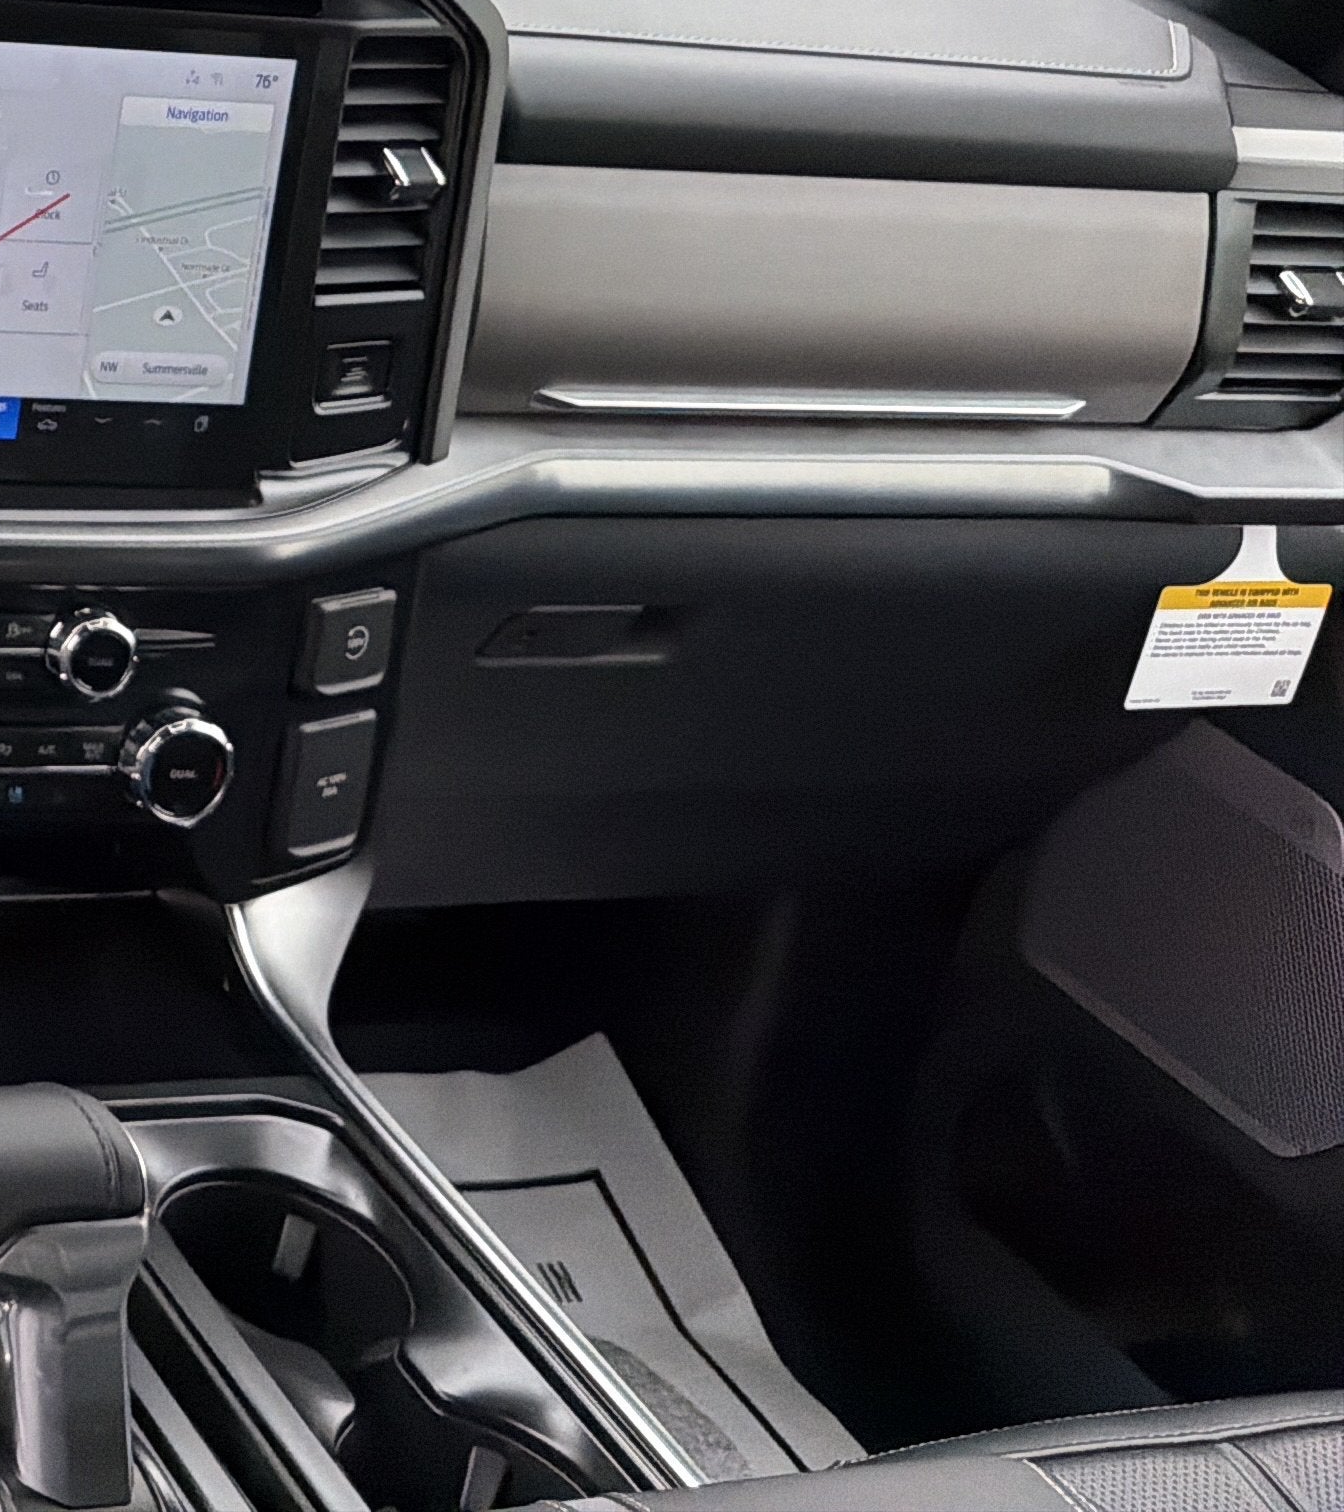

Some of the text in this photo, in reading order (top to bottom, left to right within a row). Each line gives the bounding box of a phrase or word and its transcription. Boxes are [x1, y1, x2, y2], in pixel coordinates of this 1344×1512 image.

[166, 106, 229, 123] Navigation
[21, 300, 49, 312] Seats
[99, 361, 118, 373] NW
[170, 769, 197, 779] DUAL
